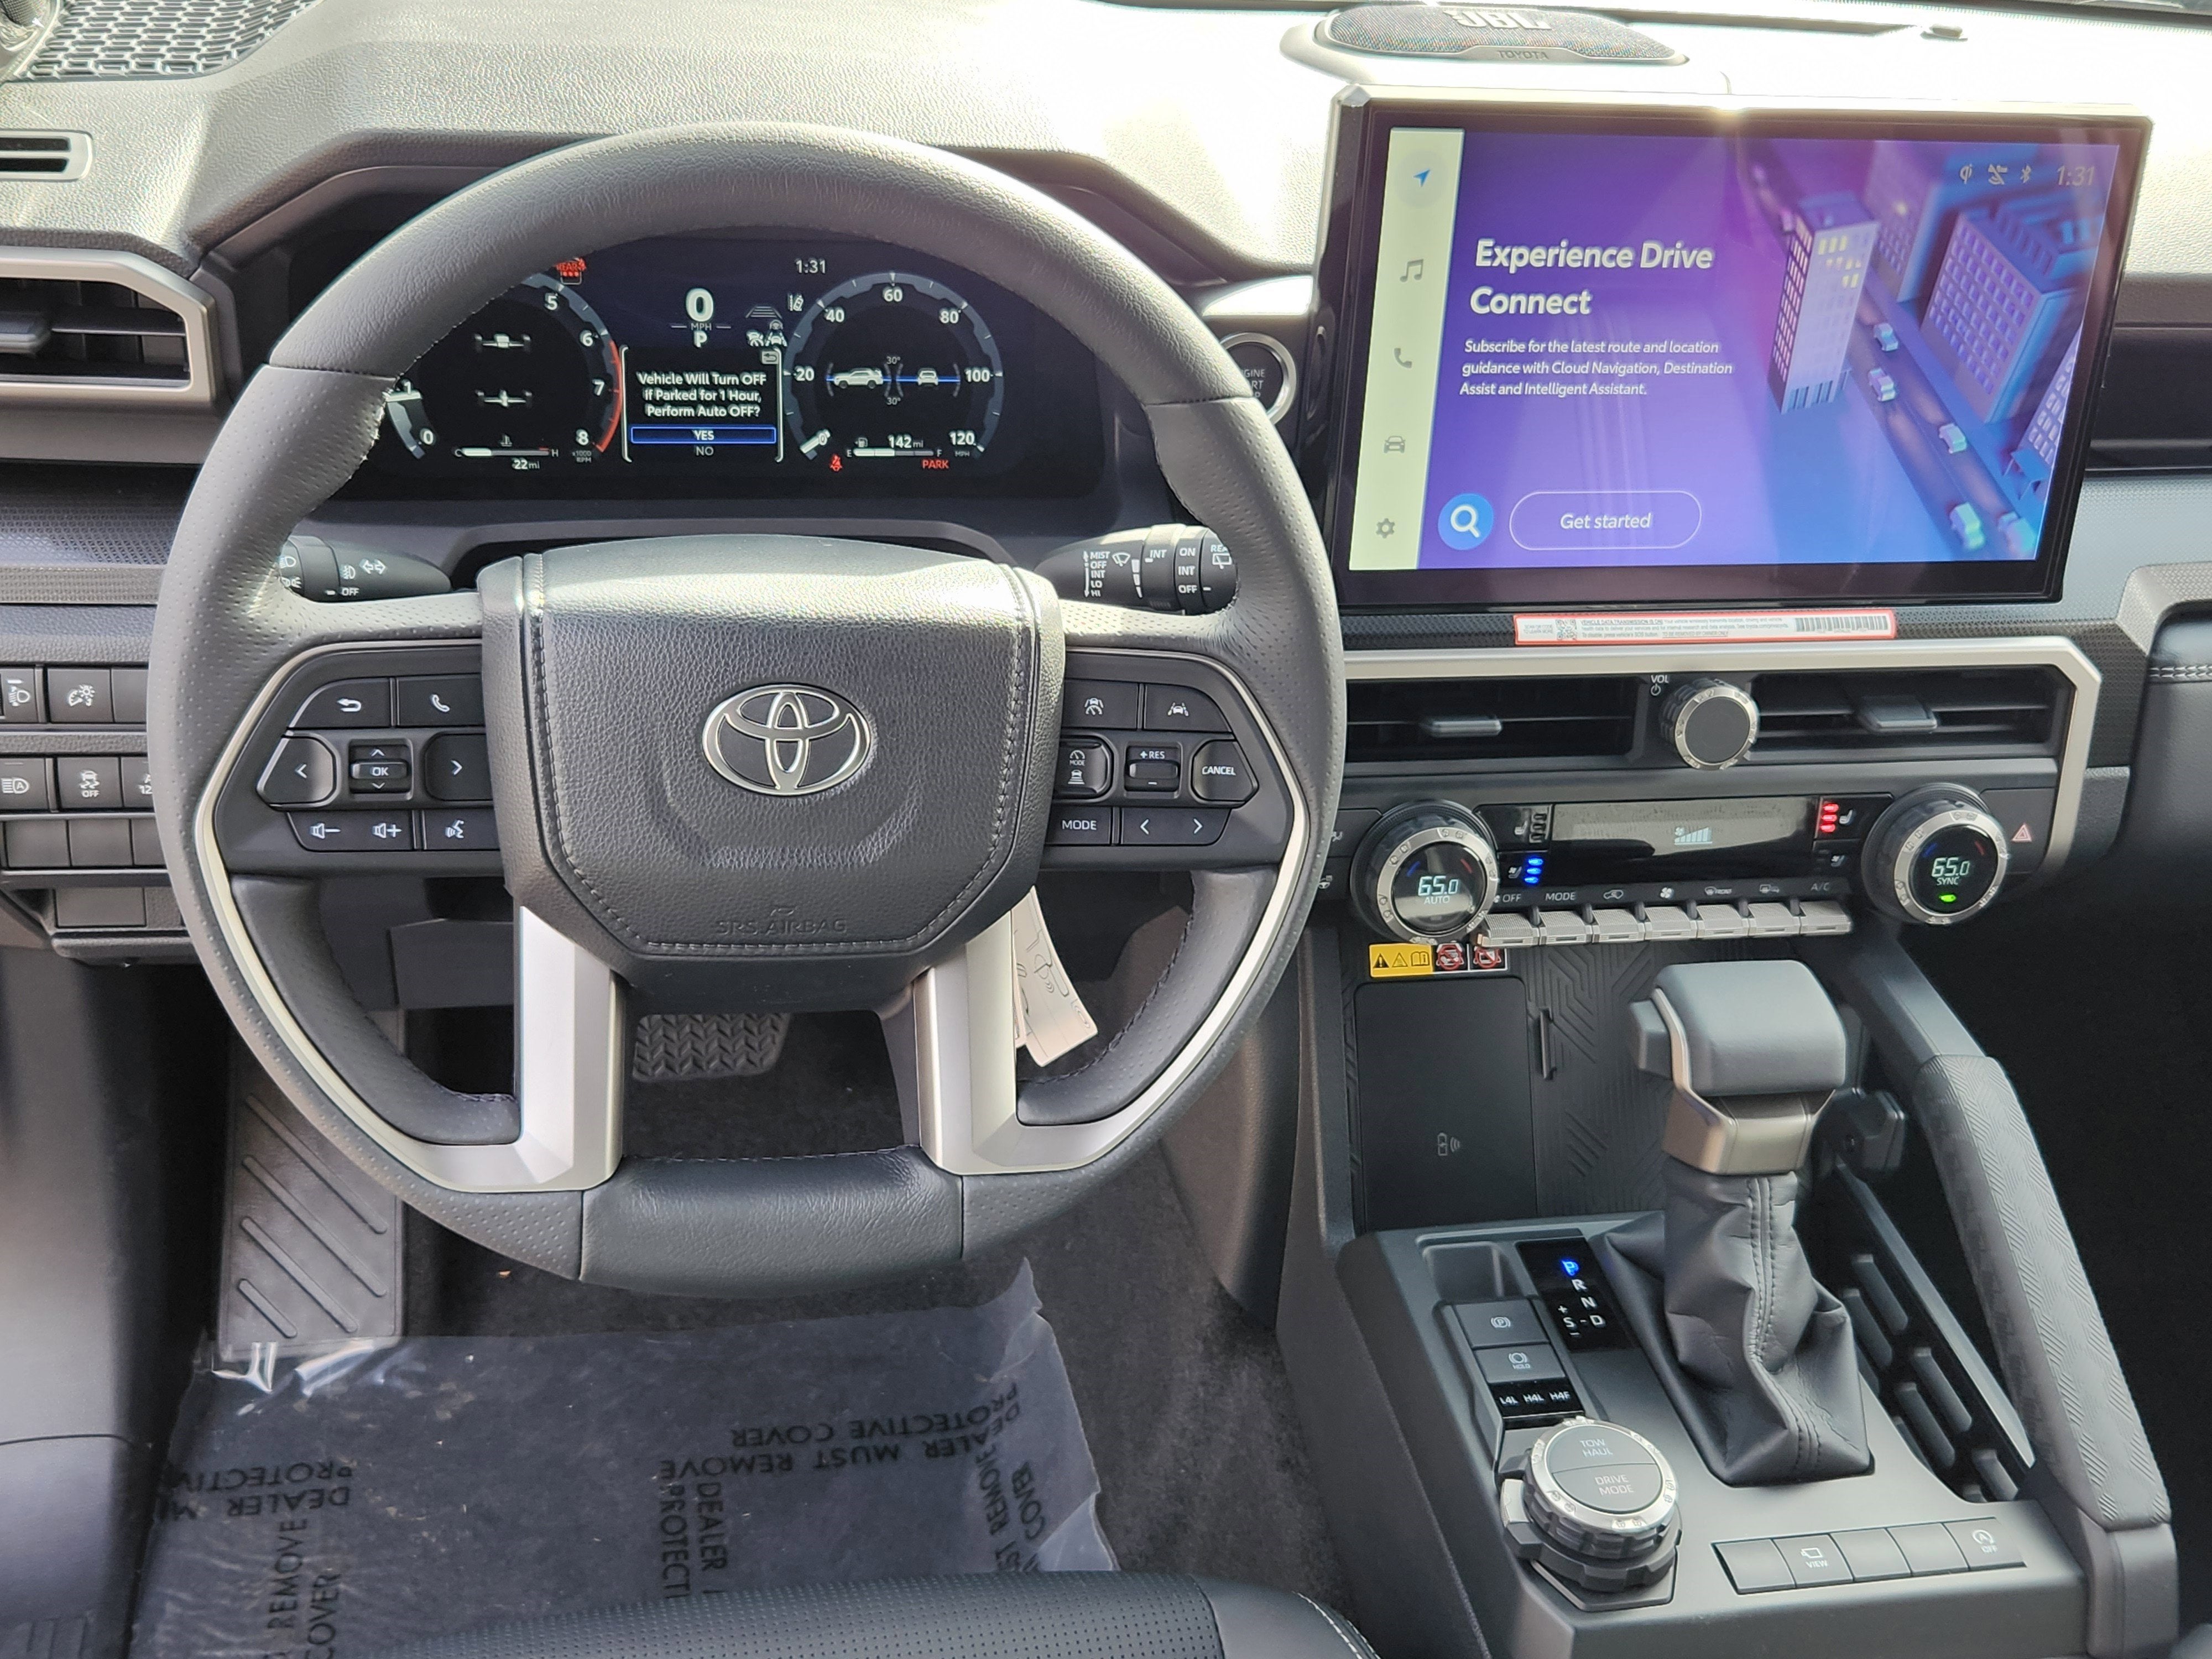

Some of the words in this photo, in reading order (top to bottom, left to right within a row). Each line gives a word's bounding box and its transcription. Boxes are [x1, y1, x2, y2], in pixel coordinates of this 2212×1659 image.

[1442, 10, 1552, 30] JBL
[1498, 50, 1550, 60] TOYOTA
[2056, 165, 2095, 187] 1:31
[1475, 238, 1634, 274] Experience
[1640, 240, 1714, 269] Drive
[795, 259, 826, 274] 1:31
[884, 288, 902, 303] 60
[1470, 286, 1592, 315] Connect
[545, 294, 559, 311] 5
[686, 288, 713, 322] 0
[826, 307, 845, 324] 40
[940, 310, 959, 324] 80
[580, 330, 594, 347] 6
[694, 331, 707, 347] P
[1464, 340, 1526, 353] Subscribe
[1528, 340, 1546, 353] for
[1548, 340, 1569, 353] the
[1571, 340, 1605, 353] latest
[1608, 341, 1641, 353] route
[1643, 340, 1667, 353] and
[1668, 341, 1719, 354] location
[886, 356, 901, 364] 30°
[796, 368, 815, 382] 20
[964, 368, 990, 383] 100
[1242, 369, 1266, 378] GINE
[1462, 361, 1521, 377] guidance
[1522, 361, 1550, 374] with
[1551, 362, 1589, 374] Cloud
[1592, 362, 1660, 377] Navigation,
[1662, 362, 1733, 375] Destination
[637, 372, 683, 385] Vehicle
[684, 372, 710, 385] Will
[712, 372, 739, 385] Turn
[740, 373, 766, 385] OFF
[592, 379, 605, 396] 7
[1459, 382, 1496, 395] Assist
[1498, 382, 1522, 395] and
[1524, 382, 1587, 398] Intelligent
[1589, 383, 1647, 396] Assistant.
[654, 388, 697, 401] Parked
[698, 388, 718, 401] for
[719, 389, 725, 400] 1
[728, 389, 761, 403] Hour,
[886, 397, 901, 405] 30°
[645, 404, 695, 417] Perform
[697, 404, 727, 417] Auto
[728, 404, 761, 417] OFF?
[420, 429, 434, 445] 0
[576, 429, 589, 446] 8
[693, 430, 714, 440] YES
[818, 432, 828, 446] 0
[888, 434, 912, 448] 142
[949, 430, 975, 445] 120
[695, 446, 714, 456] NO
[846, 449, 852, 457] E
[937, 449, 942, 457] F
[512, 458, 528, 469] 22
[529, 461, 540, 469] mi
[922, 458, 950, 469] PARK
[1559, 513, 1590, 530] Get
[1593, 513, 1652, 530] started
[1150, 549, 1167, 559] INT
[1179, 547, 1196, 557] ON
[1211, 544, 1229, 552] REA
[1090, 551, 1110, 560] MIST
[1090, 560, 1107, 569] OFF
[1178, 565, 1196, 576] INT
[1091, 570, 1105, 579] INT
[1091, 580, 1103, 589] LO
[1178, 584, 1197, 594] OFF
[341, 587, 359, 596] OFF
[1091, 589, 1101, 598] HI
[1650, 675, 1669, 684] VOL
[372, 766, 388, 776] OK
[1202, 765, 1237, 776] CANCEL
[81, 790, 100, 798] OFF
[1062, 820, 1097, 830] MODE
[1931, 857, 1970, 878] 65.0
[1418, 875, 1459, 896] 65.0
[1811, 883, 1830, 892] A/C
[1937, 876, 1960, 886] SYNC
[1424, 895, 1451, 905] AUTO
[1502, 893, 1521, 903] OFF
[1545, 891, 1576, 901] MODE
[718, 920, 758, 935] SRS
[765, 919, 847, 935] AIRBAG
[1561, 1259, 1579, 1276] P
[1572, 1279, 1587, 1291] R
[1581, 1296, 1597, 1309] N
[1563, 1317, 1575, 1329] S
[1589, 1314, 1605, 1327] D
[1499, 1396, 1519, 1406] L4L
[1522, 1392, 1545, 1403] H4L
[1549, 1390, 1571, 1401] H4F
[851, 1383, 1018, 1438] PROTECTIVE
[731, 1423, 834, 1448] COVER
[922, 1402, 1020, 1459] DEALER
[1580, 1438, 1605, 1448] TOW
[815, 1444, 899, 1469] MUST
[1582, 1448, 1613, 1457] HAUL
[661, 1452, 793, 1480] REMOVE
[1595, 1474, 1629, 1485] DRIVE
[1598, 1484, 1634, 1496] MODE
[227, 1486, 349, 1517] DEALER
[697, 1483, 728, 1572] DEALER
[660, 1485, 691, 1599] PROTECTI
[1981, 1545, 1997, 1553] OFF
[1806, 1559, 1828, 1569] VIEW
[267, 1519, 307, 1629] REMOVE
